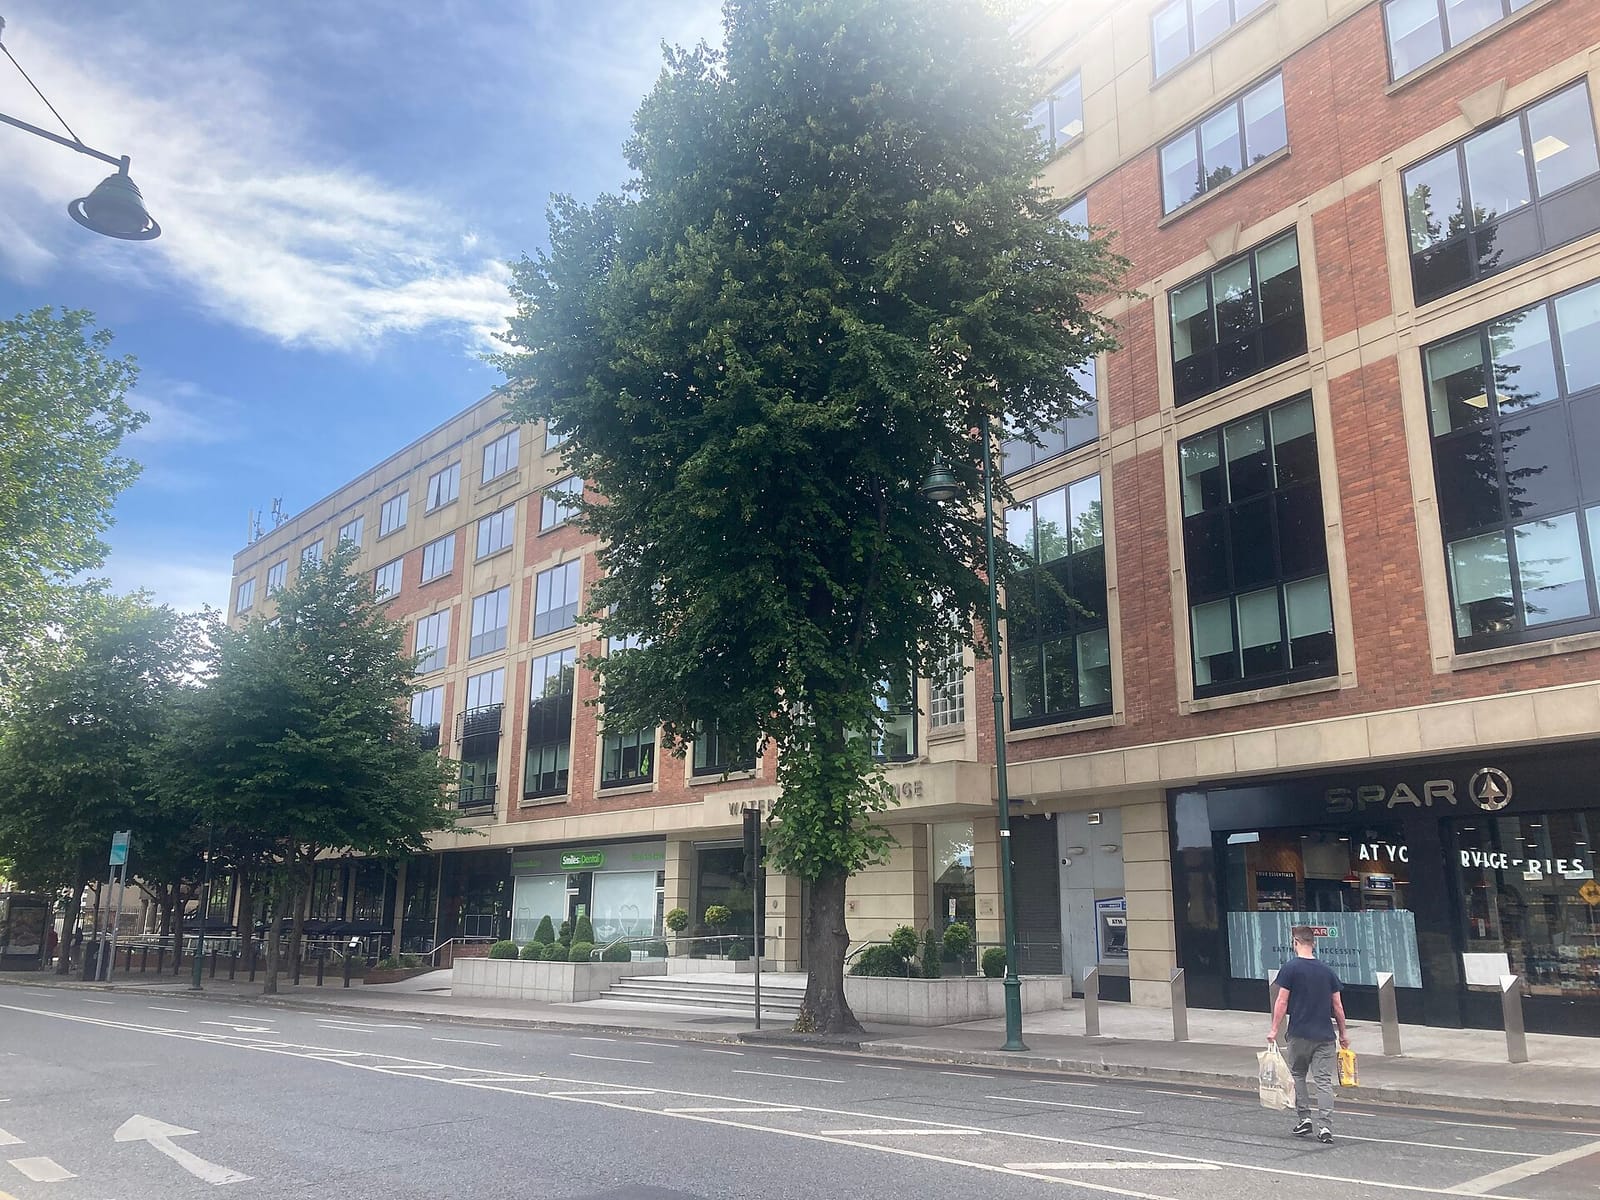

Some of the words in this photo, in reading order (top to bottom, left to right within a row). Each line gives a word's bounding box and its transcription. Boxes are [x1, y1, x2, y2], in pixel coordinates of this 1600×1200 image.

[1325, 779, 1457, 813] SPAR
[562, 855, 580, 865] Smiles
[1360, 844, 1379, 861] AT
[1512, 858, 1585, 874] RIES
